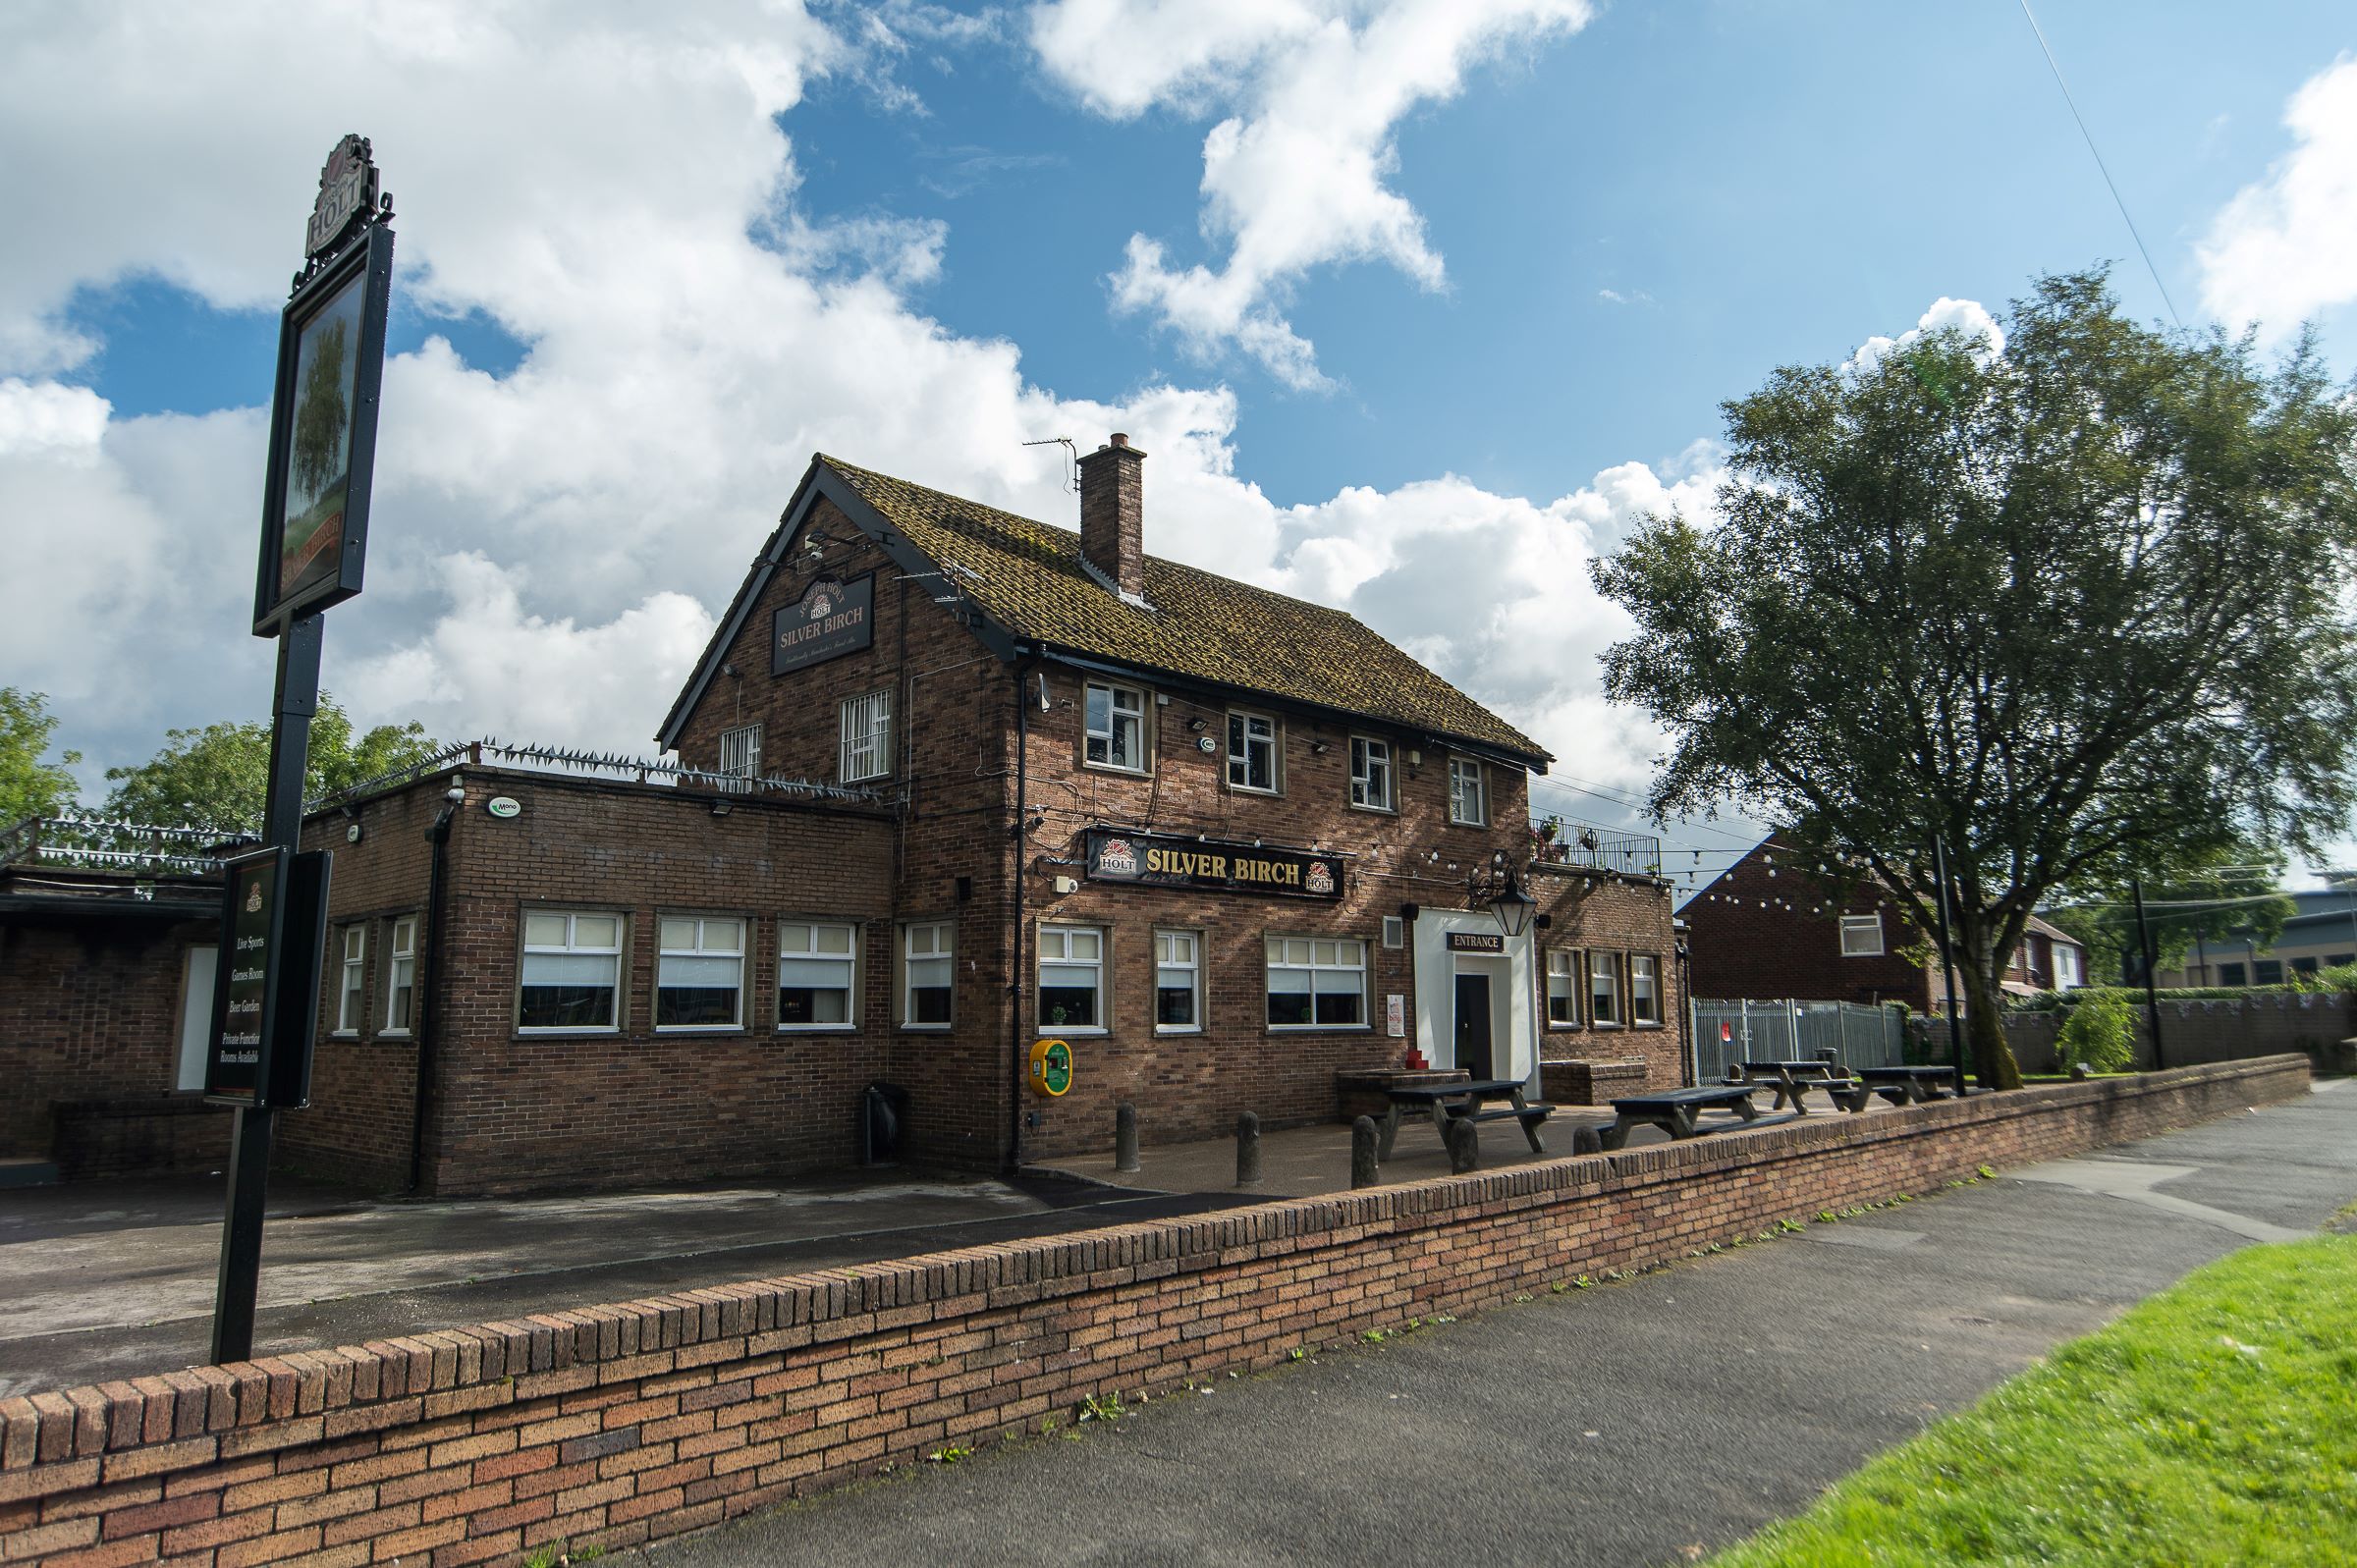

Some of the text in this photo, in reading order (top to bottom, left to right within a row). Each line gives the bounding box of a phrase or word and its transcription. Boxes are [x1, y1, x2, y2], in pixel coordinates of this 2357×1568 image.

[309, 176, 358, 243] HOLT
[799, 582, 845, 618] JOSEPH HOLT
[811, 605, 830, 617] HOLT
[781, 607, 862, 648] SILVER BIRCH
[1102, 858, 1134, 870] HOLT
[1146, 848, 1299, 885] SILVER BIRCH
[1307, 879, 1333, 890] HOLT
[237, 936, 264, 951] Live Sports
[1454, 935, 1499, 947] ENTRANCE
[232, 967, 264, 981] Games Room
[229, 999, 260, 1013] Beer Garden
[222, 1032, 239, 1045] Private
[220, 1050, 238, 1062] Rooms
